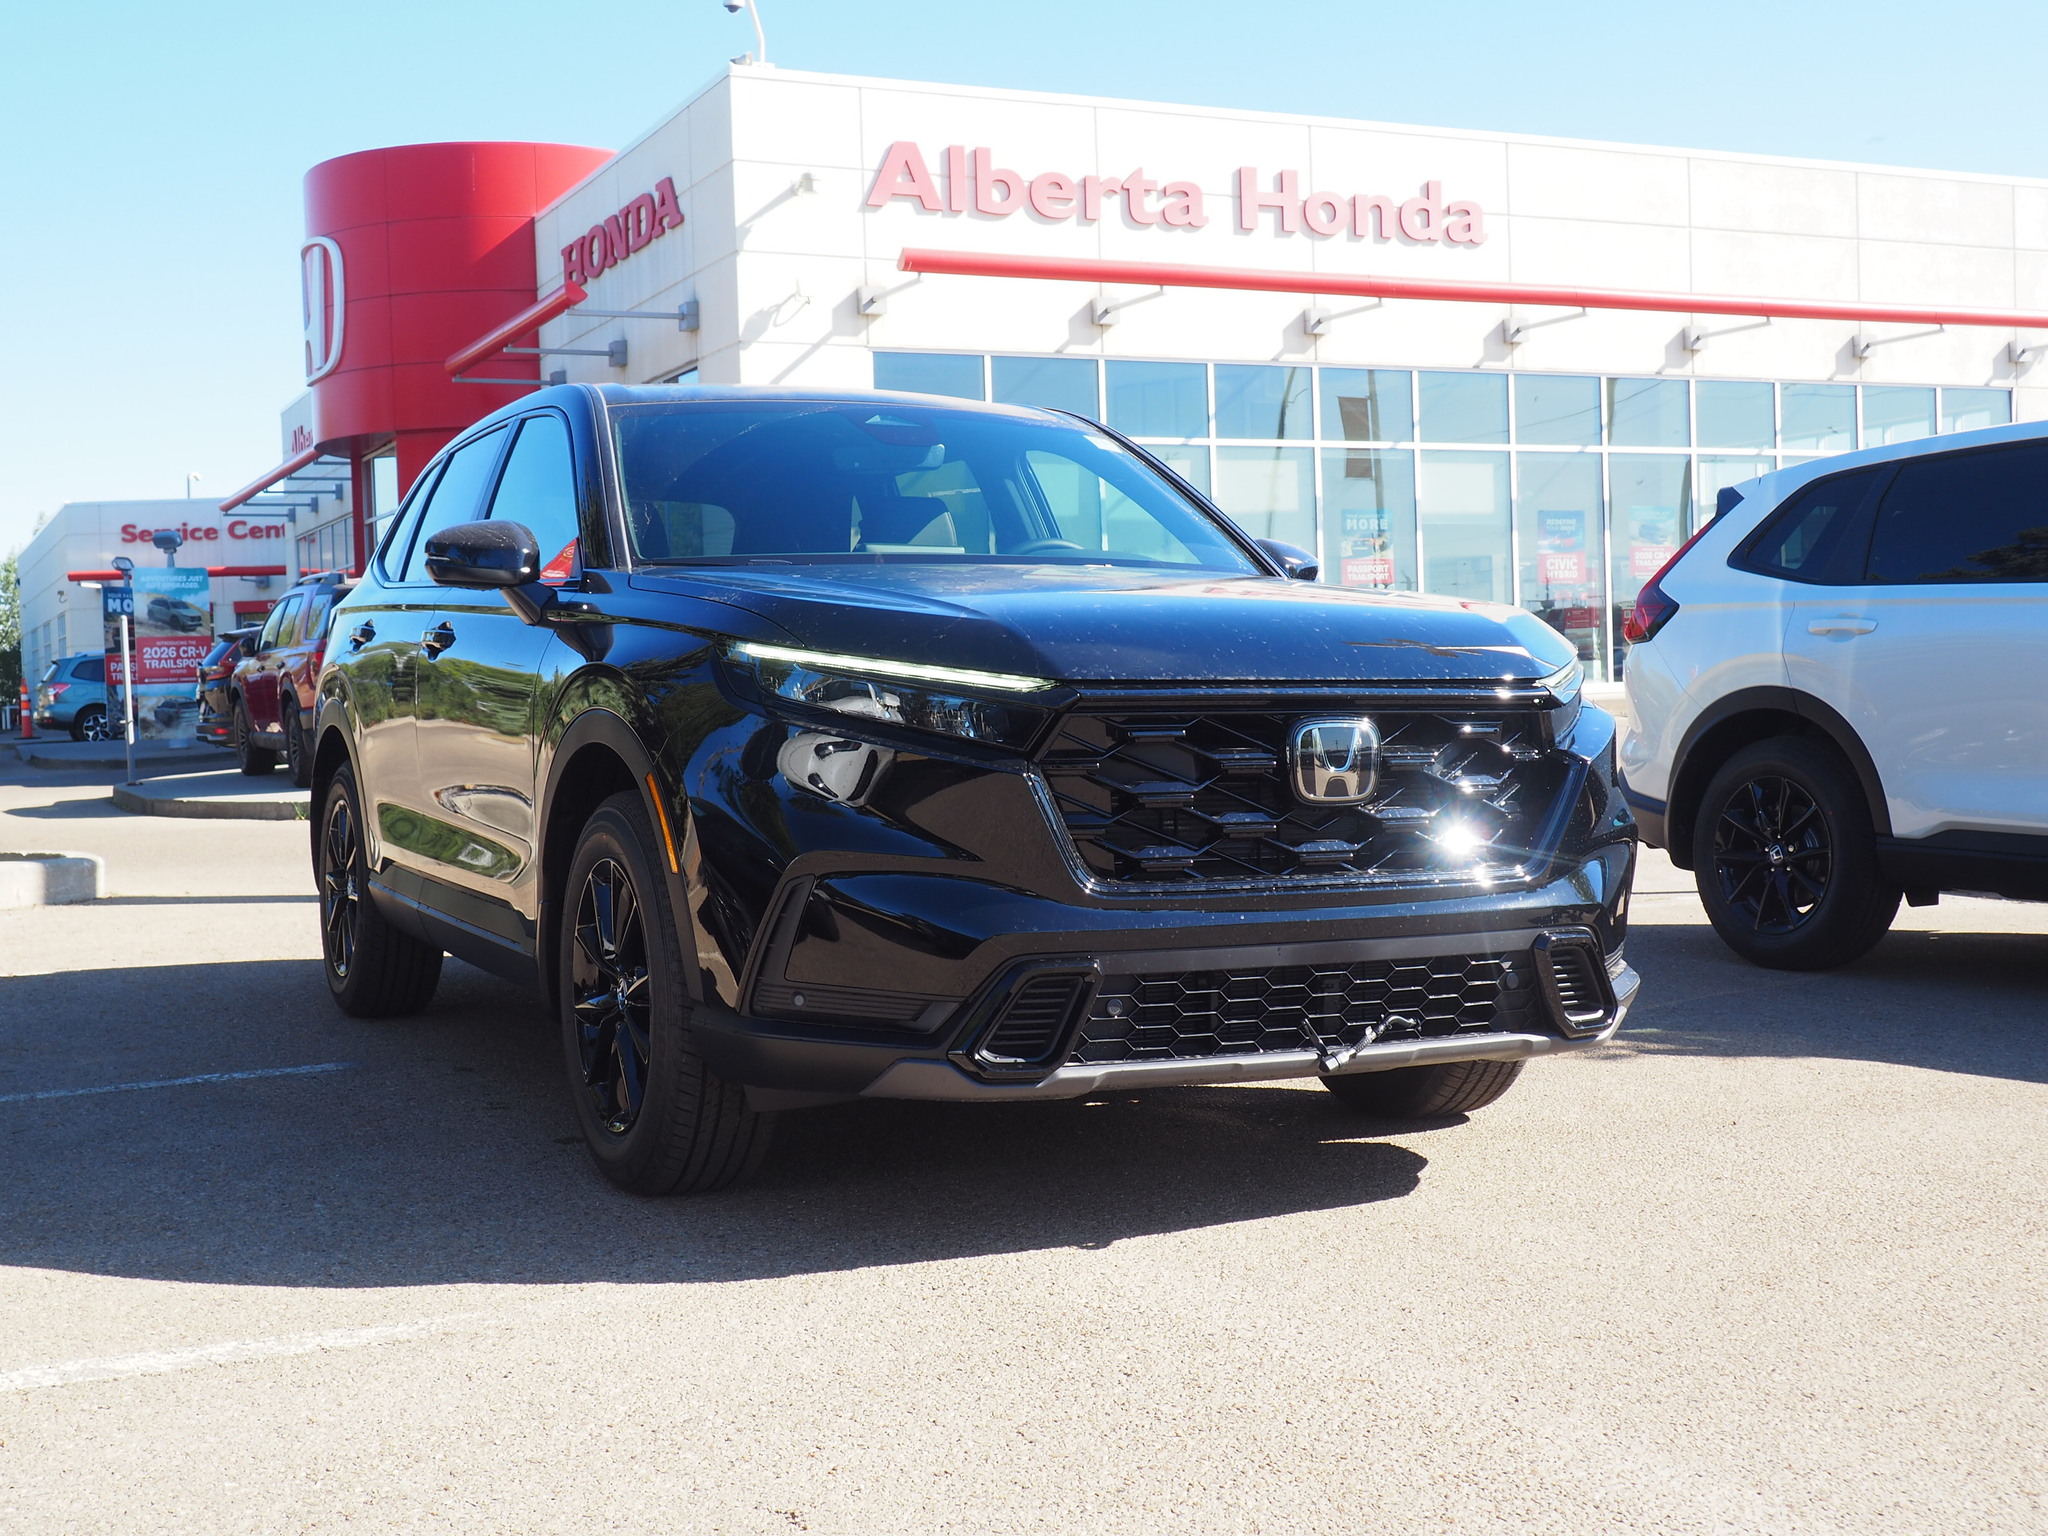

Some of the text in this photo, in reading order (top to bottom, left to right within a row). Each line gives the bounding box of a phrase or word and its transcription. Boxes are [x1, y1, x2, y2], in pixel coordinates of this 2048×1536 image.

[866, 140, 1489, 245] Alberta Honda
[561, 176, 685, 287] HONDA
[1346, 518, 1389, 530] MORE
[1346, 564, 1389, 574] PASSPORT
[1546, 558, 1578, 570] CIVIC
[1547, 569, 1579, 579] HYBRID
[143, 645, 208, 659] 2026 CR-V
